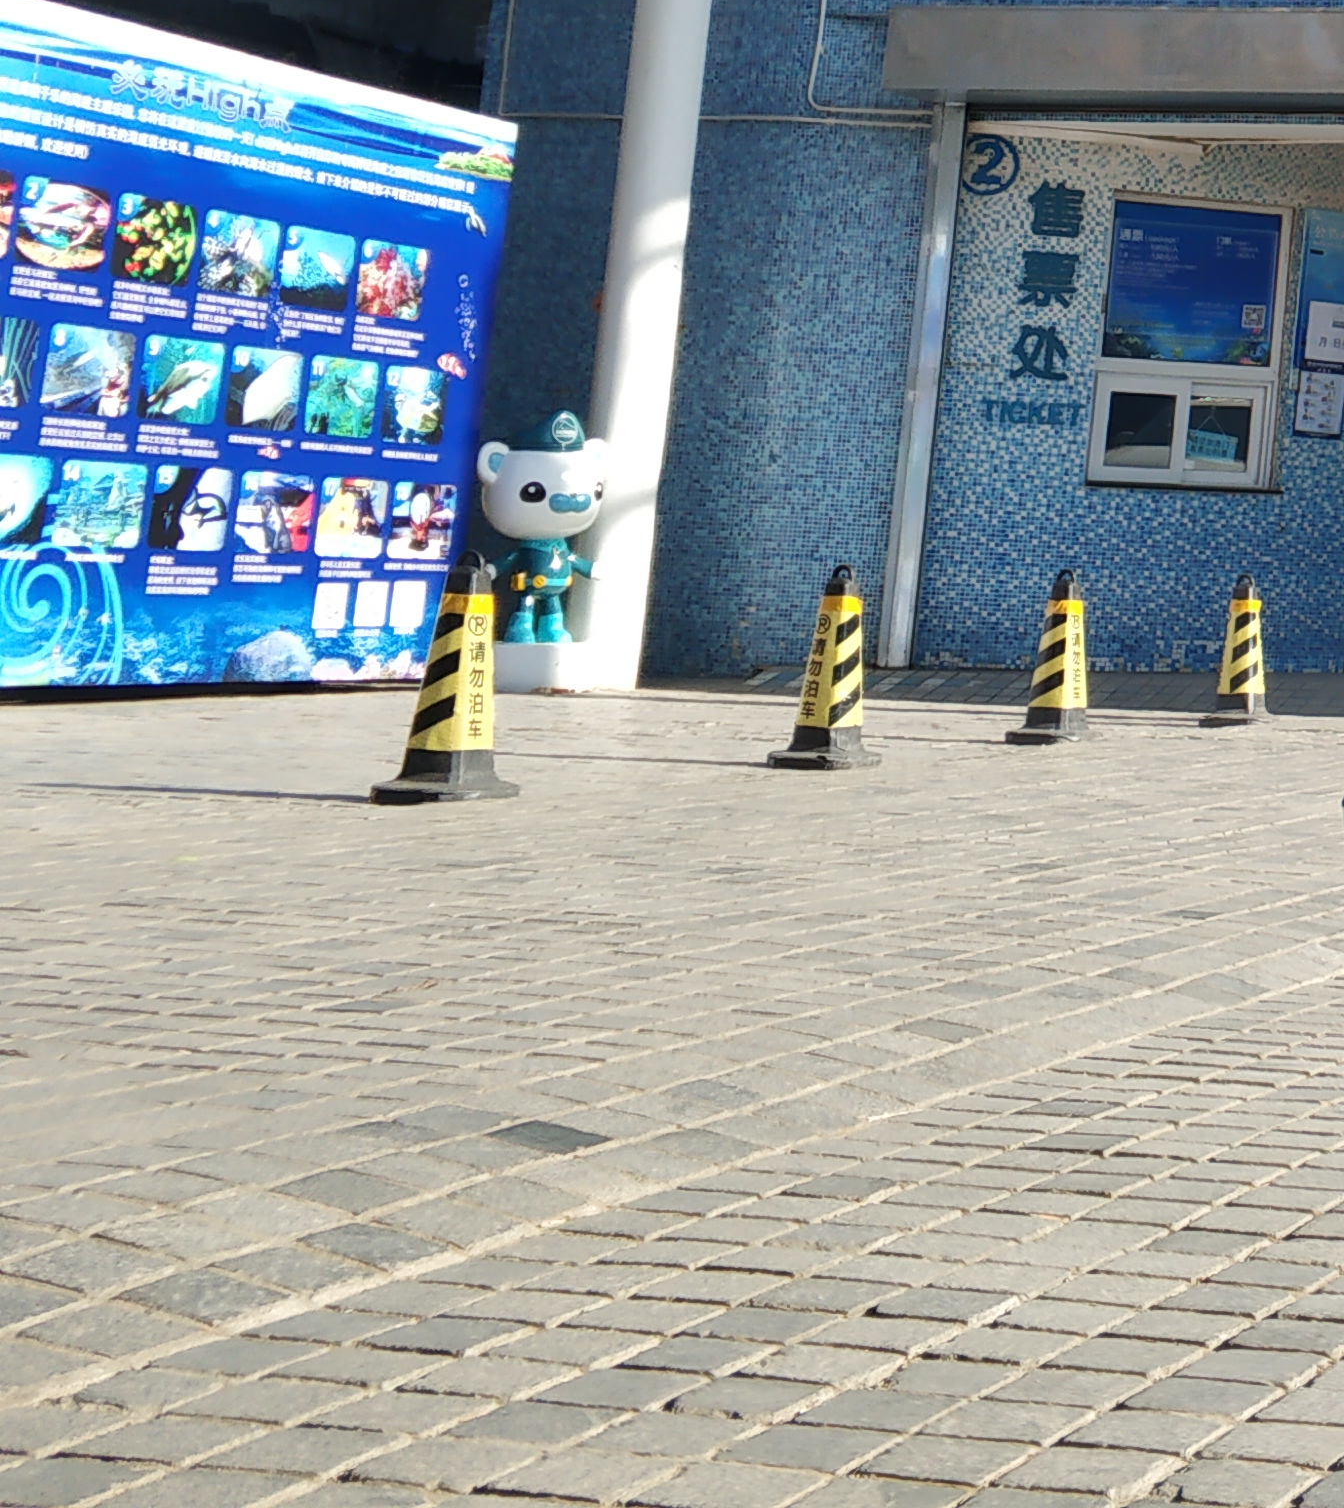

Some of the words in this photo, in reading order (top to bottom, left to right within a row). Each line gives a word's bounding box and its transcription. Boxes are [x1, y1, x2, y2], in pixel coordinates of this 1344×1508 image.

[1010, 181, 1086, 380] 售票处
[982, 399, 1086, 426] TICKET
[468, 641, 486, 740] 请勿泊车
[800, 638, 827, 720] 请勿泊车
